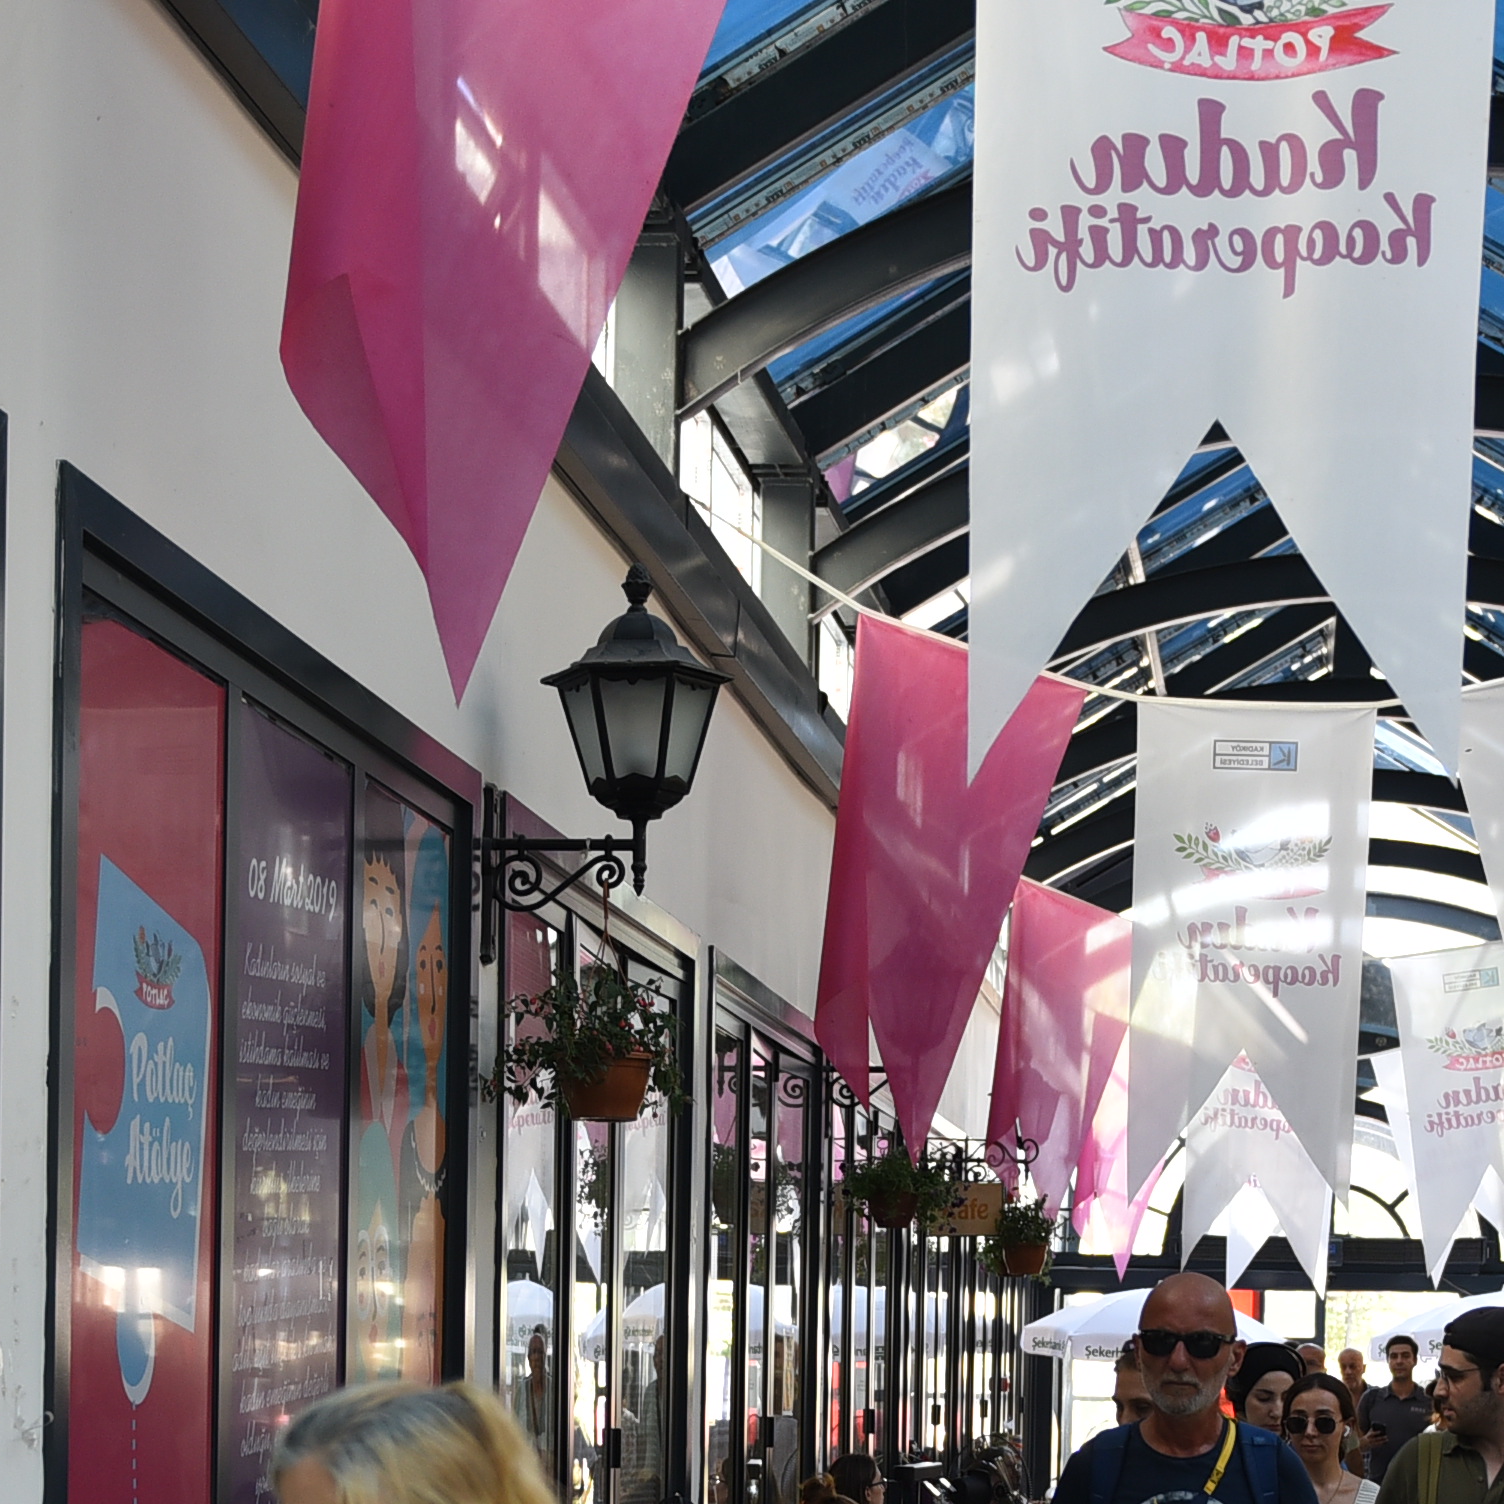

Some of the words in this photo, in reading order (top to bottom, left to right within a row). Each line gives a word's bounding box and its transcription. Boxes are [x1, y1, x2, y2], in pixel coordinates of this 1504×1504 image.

[248, 857, 267, 900] 08
[269, 855, 304, 910] Mart
[305, 873, 337, 923] 2019
[129, 1031, 197, 1121] Potlaç
[124, 1114, 194, 1219] Atölye
